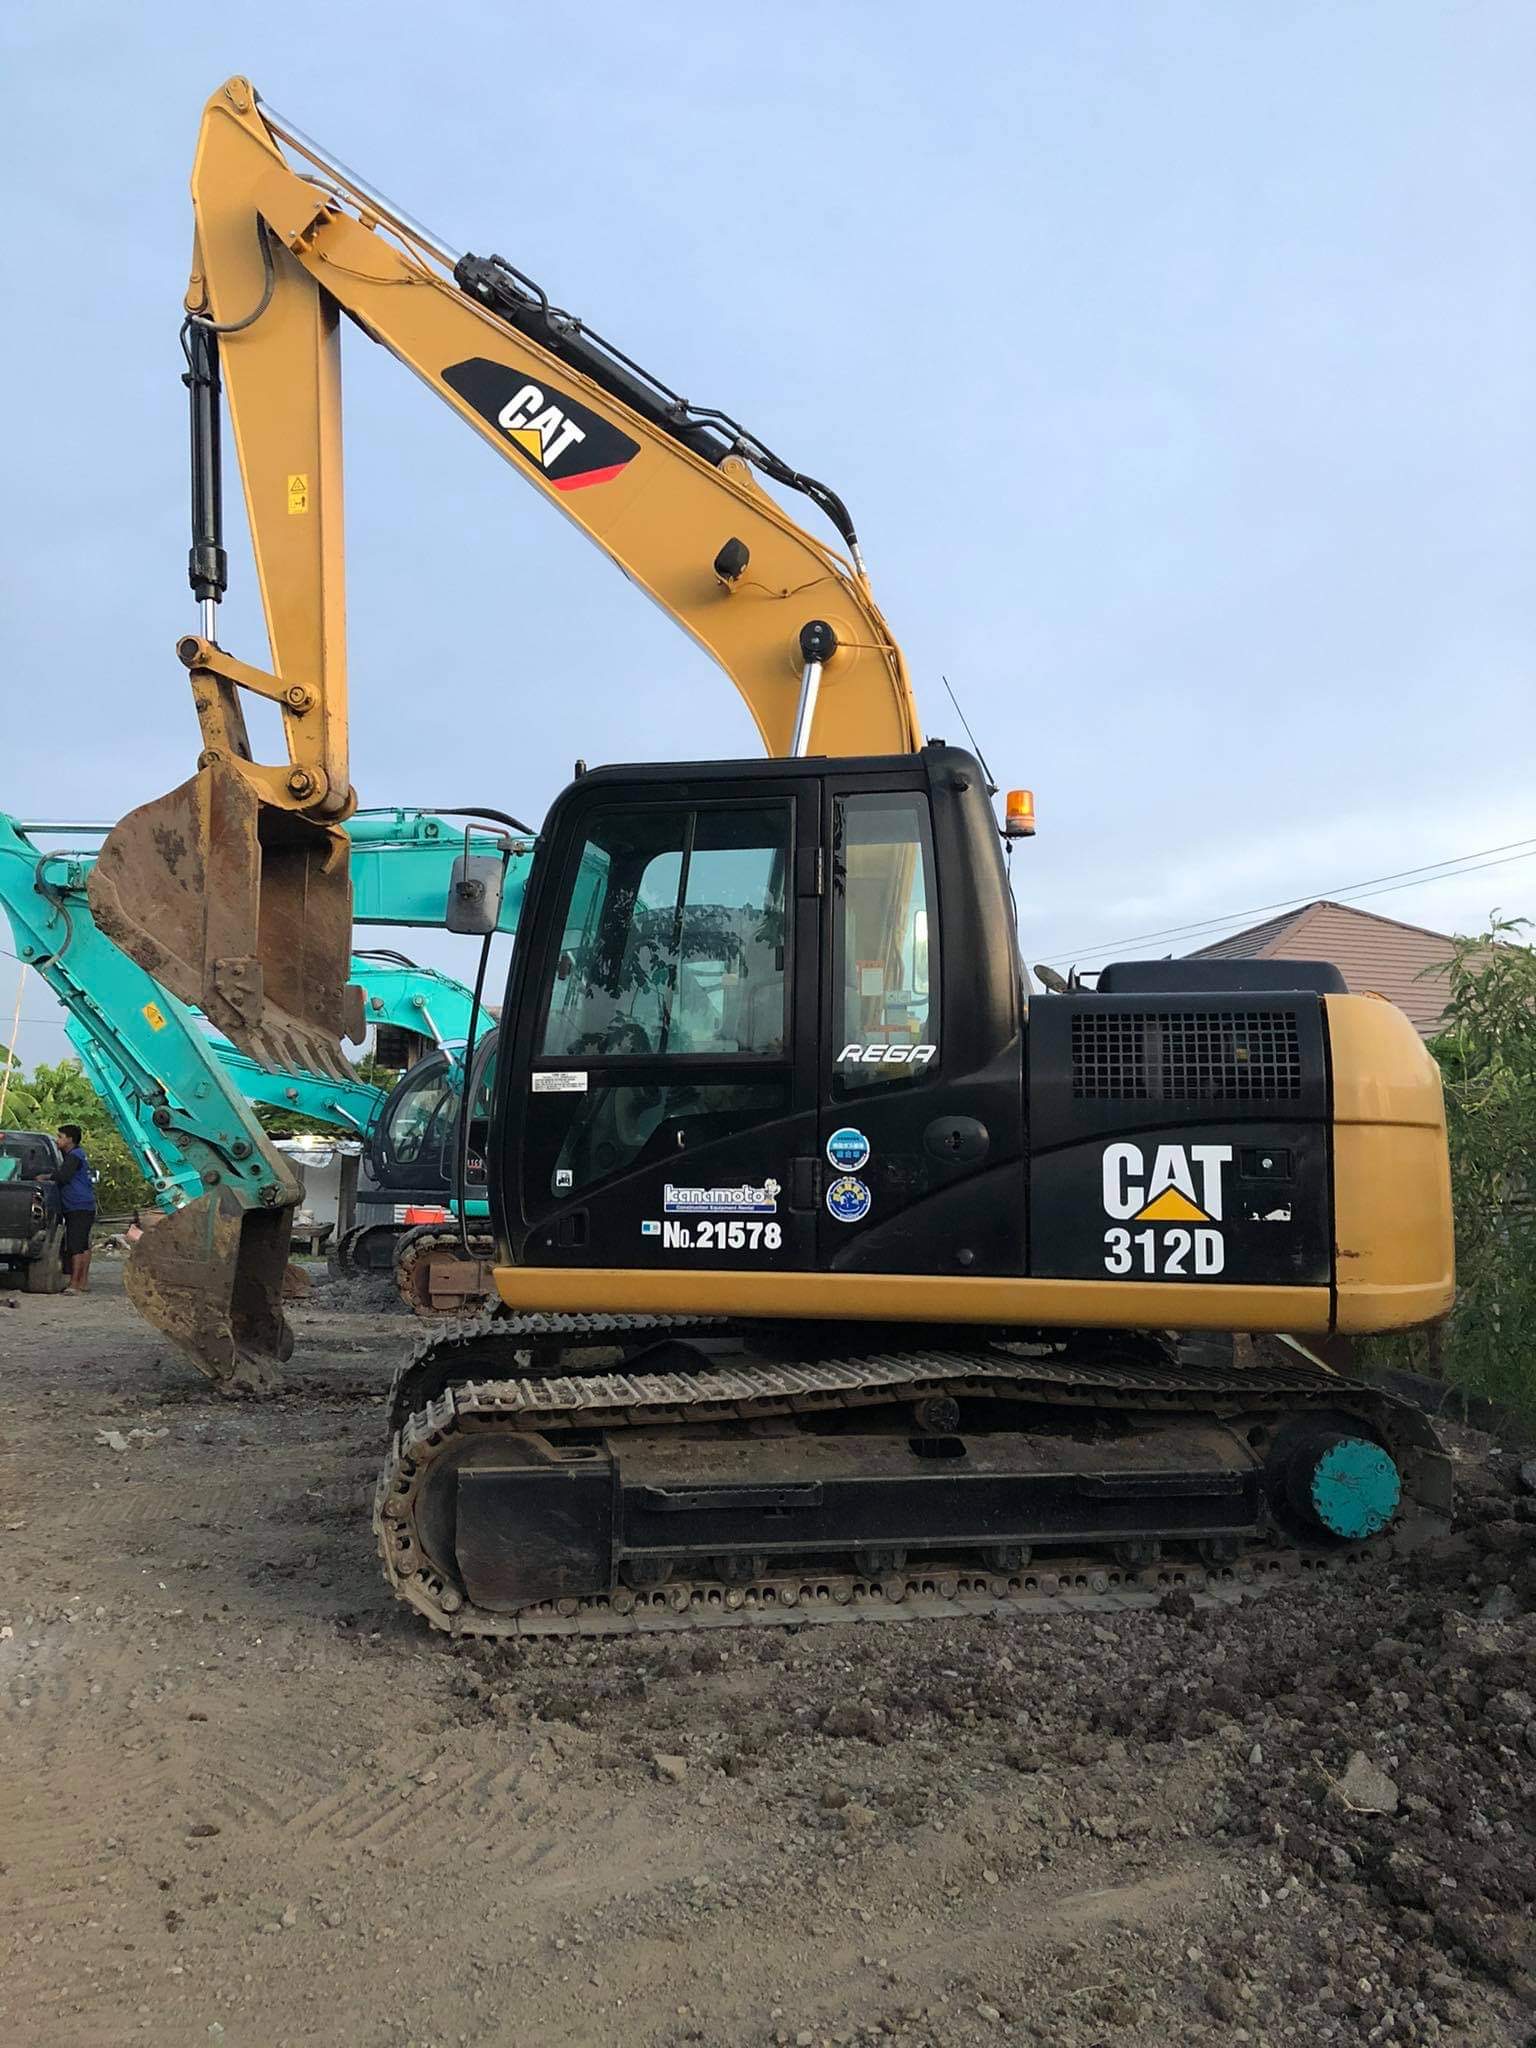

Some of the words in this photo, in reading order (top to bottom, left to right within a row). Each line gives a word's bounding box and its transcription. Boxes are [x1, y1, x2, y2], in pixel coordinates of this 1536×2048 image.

[498, 384, 587, 468] CAT
[836, 1044, 937, 1063] REGA
[665, 1184, 765, 1203] kanamoto
[1102, 1142, 1233, 1221] CAT
[1104, 1227, 1225, 1275] 312D
